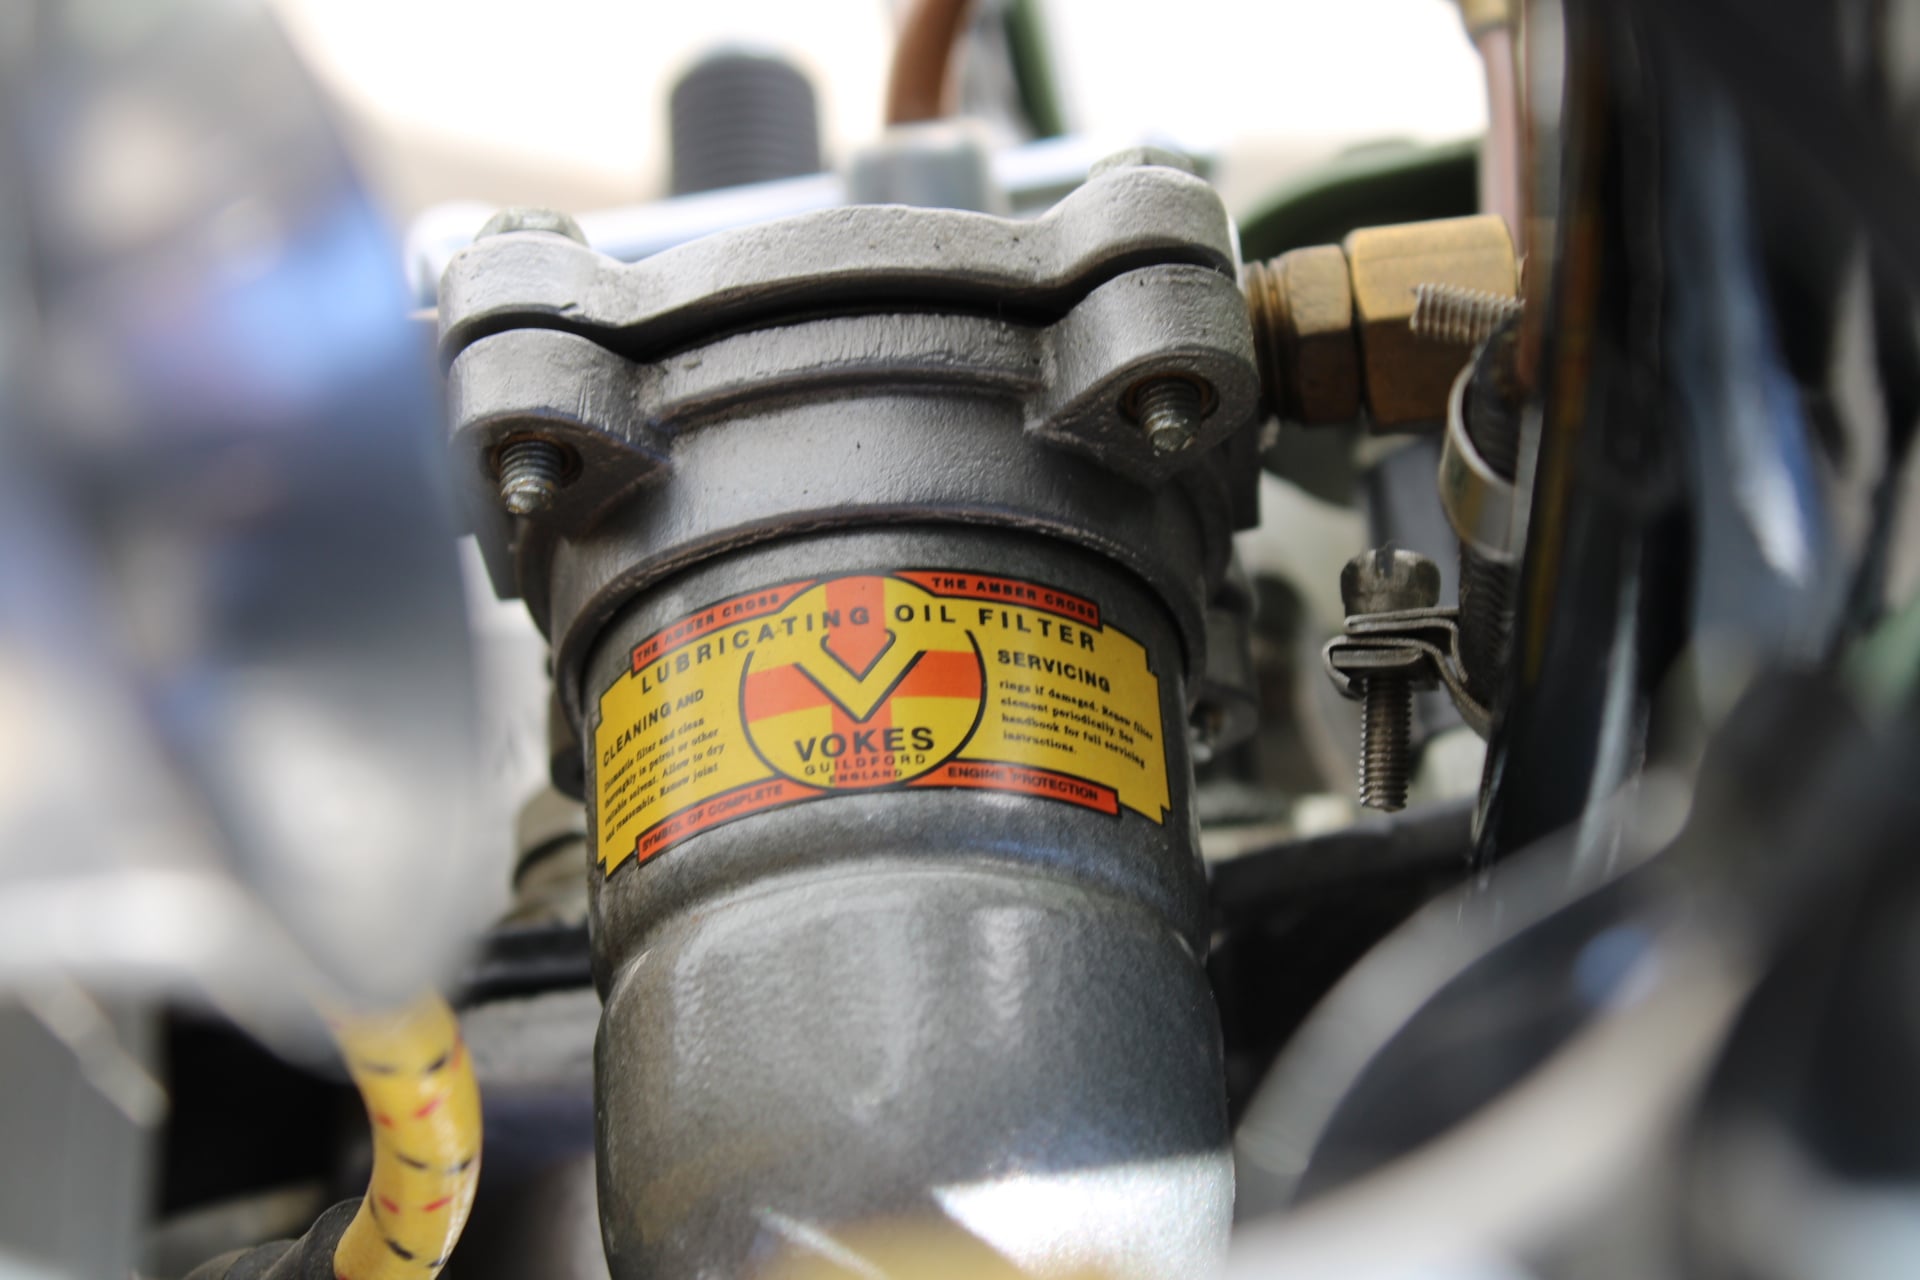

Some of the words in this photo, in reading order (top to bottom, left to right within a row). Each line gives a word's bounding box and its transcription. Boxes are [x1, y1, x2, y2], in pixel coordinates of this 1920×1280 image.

[932, 577, 967, 590] THE
[976, 581, 1037, 600] AMBER
[1044, 593, 1095, 619] CROSS
[636, 641, 659, 662] THE
[722, 594, 779, 617] CROSS
[642, 606, 870, 695] LUBRICATING
[895, 604, 956, 623] OIL
[979, 608, 1095, 652] FILTER
[998, 649, 1111, 694] SERVICING
[1000, 680, 1031, 695] rings
[1035, 684, 1045, 697] if
[603, 702, 671, 767] CLEANING
[676, 689, 704, 711] AND
[691, 728, 719, 746] other
[794, 727, 935, 763] VOKES
[1064, 725, 1080, 739] for
[693, 752, 703, 762] to
[706, 743, 725, 757] dry
[804, 754, 926, 776] GUILDFORD
[829, 769, 902, 784] ENGLAND
[948, 766, 1007, 782] ENGINE
[1010, 771, 1098, 801] PROTECTION
[688, 809, 705, 825] OF
[708, 784, 783, 816] COMPLETE
